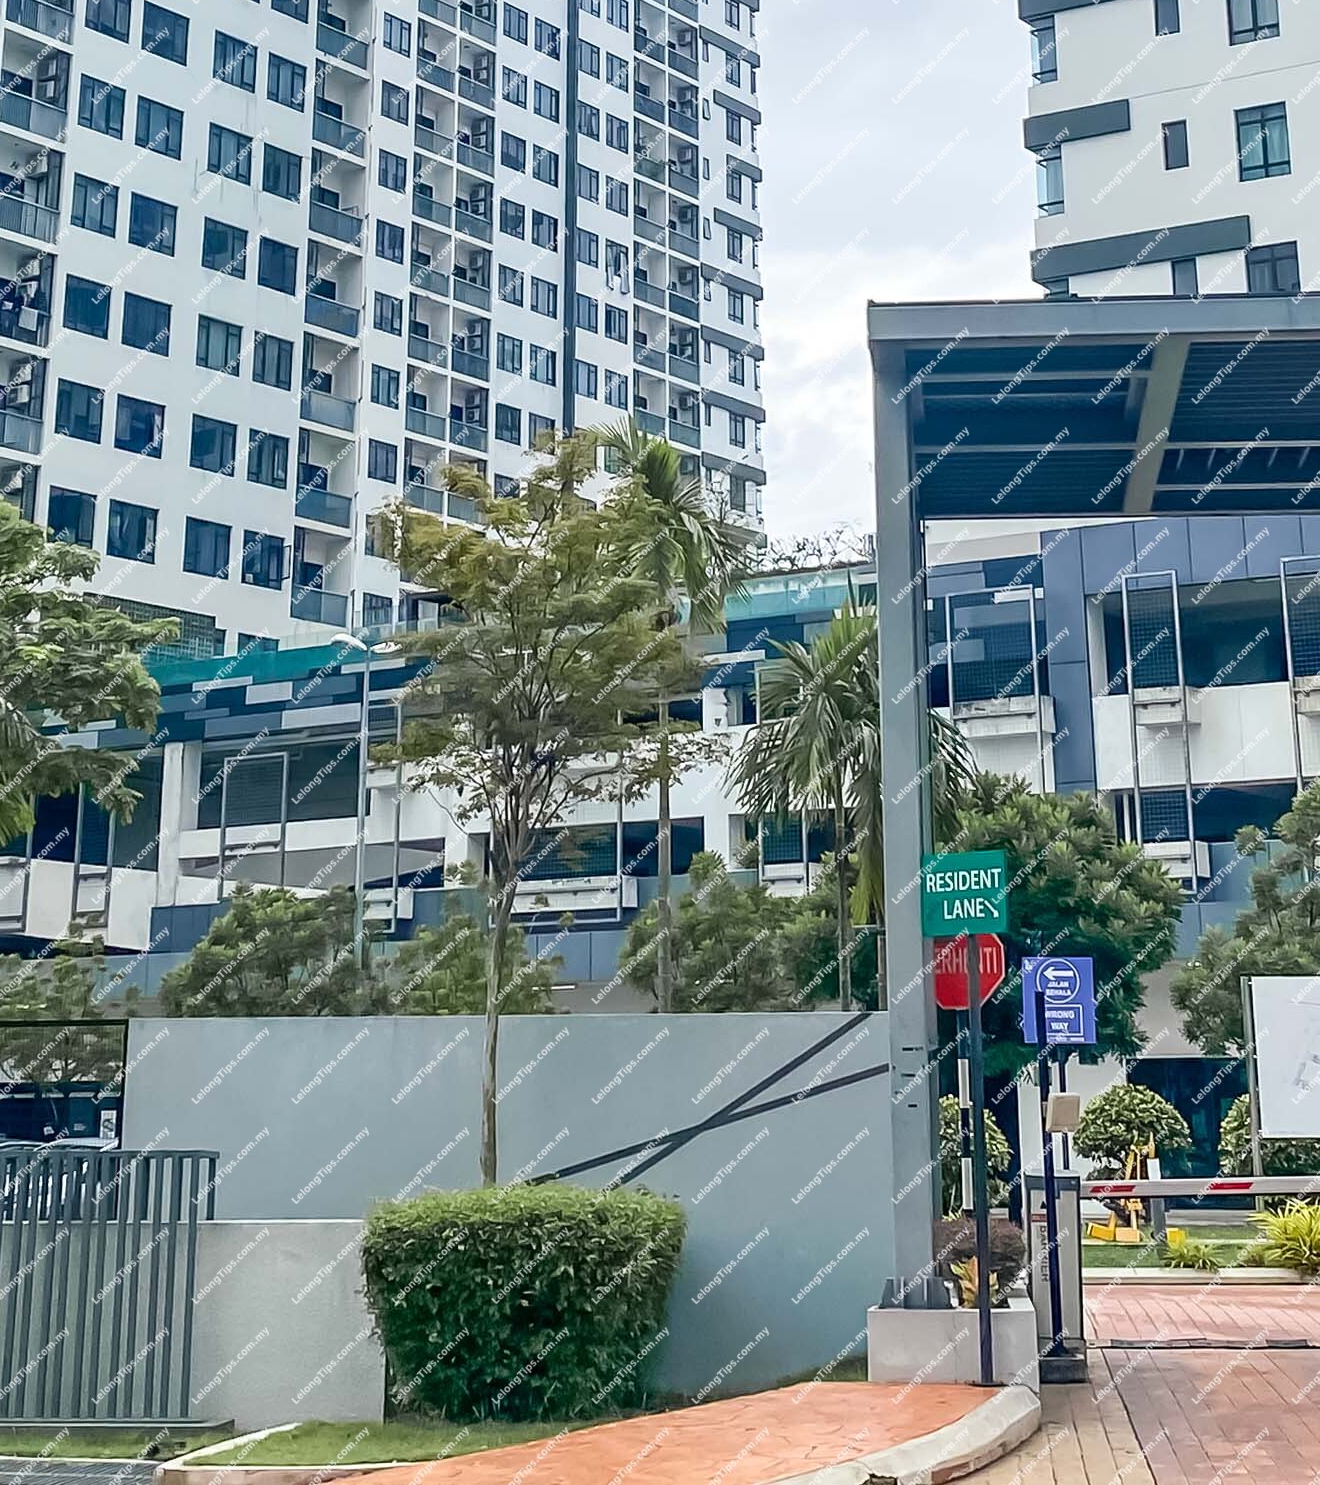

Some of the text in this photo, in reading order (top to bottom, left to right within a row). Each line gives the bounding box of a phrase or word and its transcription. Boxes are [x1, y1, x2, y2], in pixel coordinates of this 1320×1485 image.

[926, 868, 1002, 893] RESIDENT
[944, 898, 985, 920] LANE
[1050, 1022, 1069, 1031] WAY
